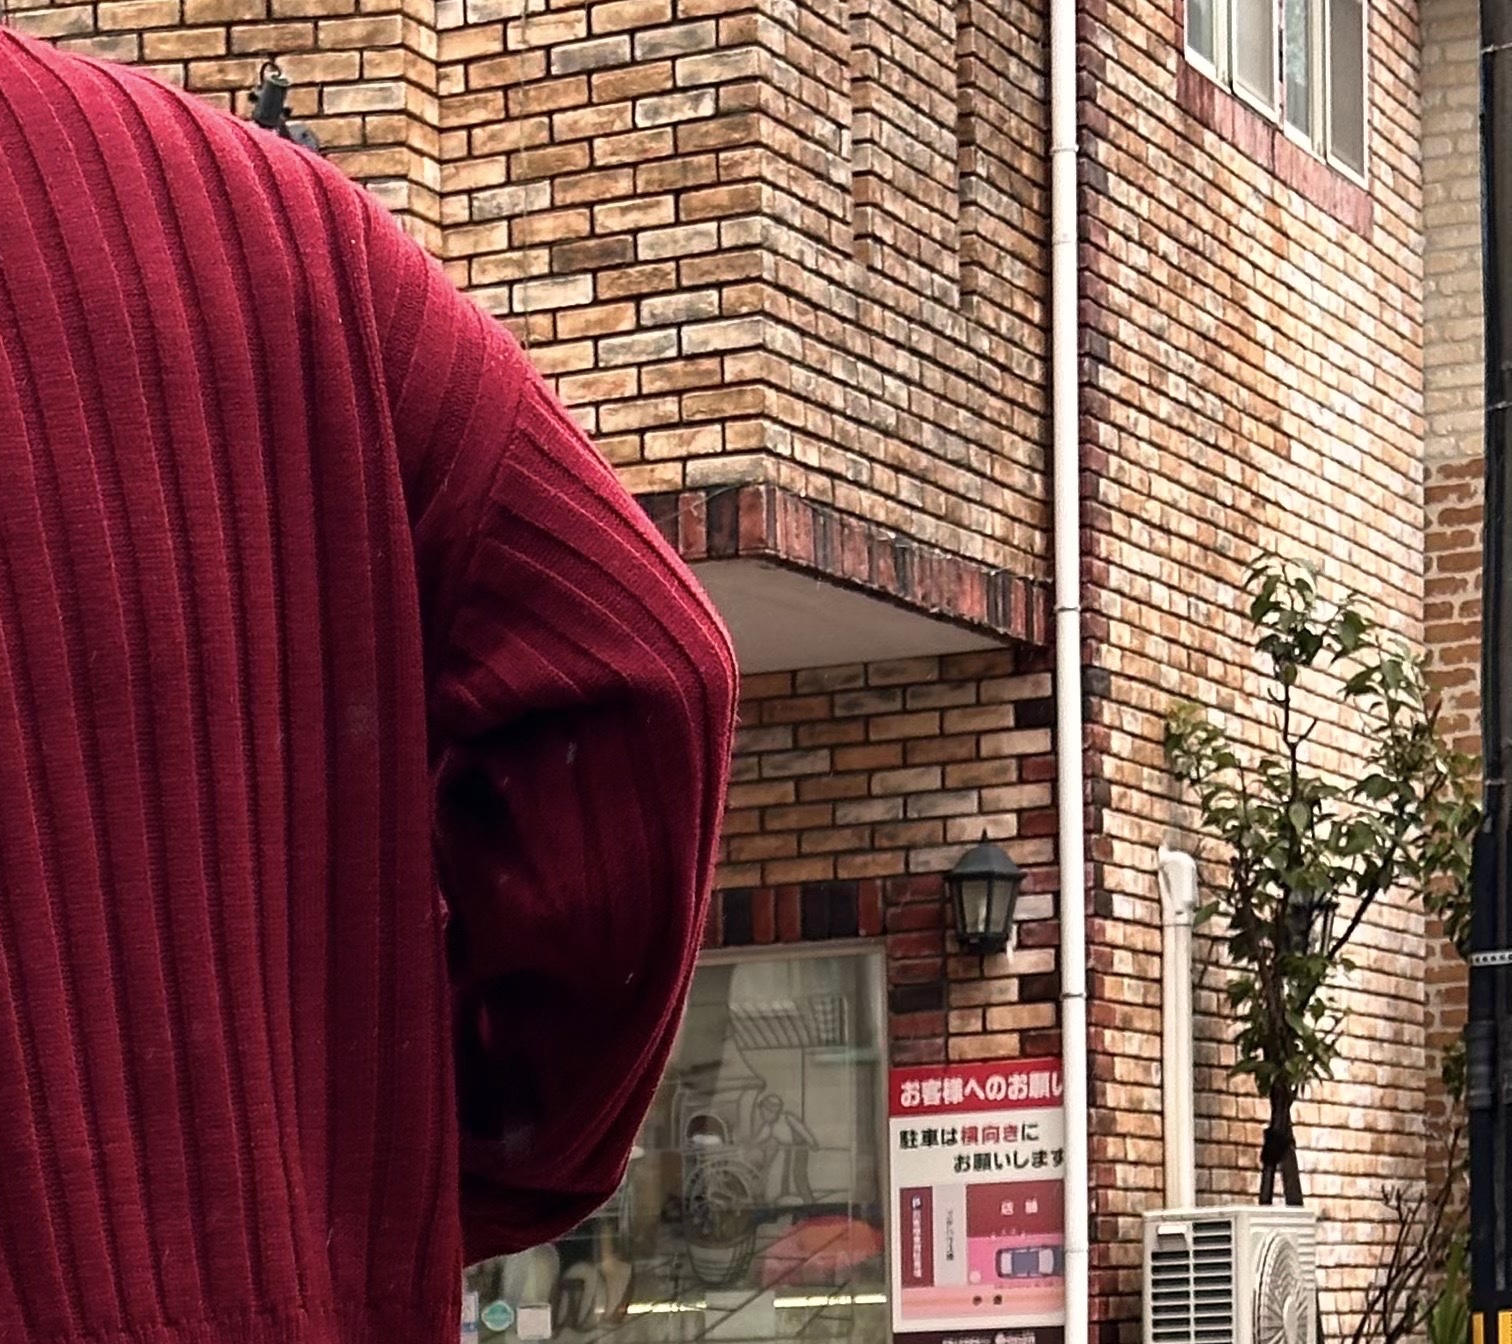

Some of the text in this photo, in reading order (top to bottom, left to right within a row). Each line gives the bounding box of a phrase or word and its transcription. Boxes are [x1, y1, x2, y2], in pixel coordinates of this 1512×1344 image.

[899, 1123, 1040, 1149] 駐車は横向きに
